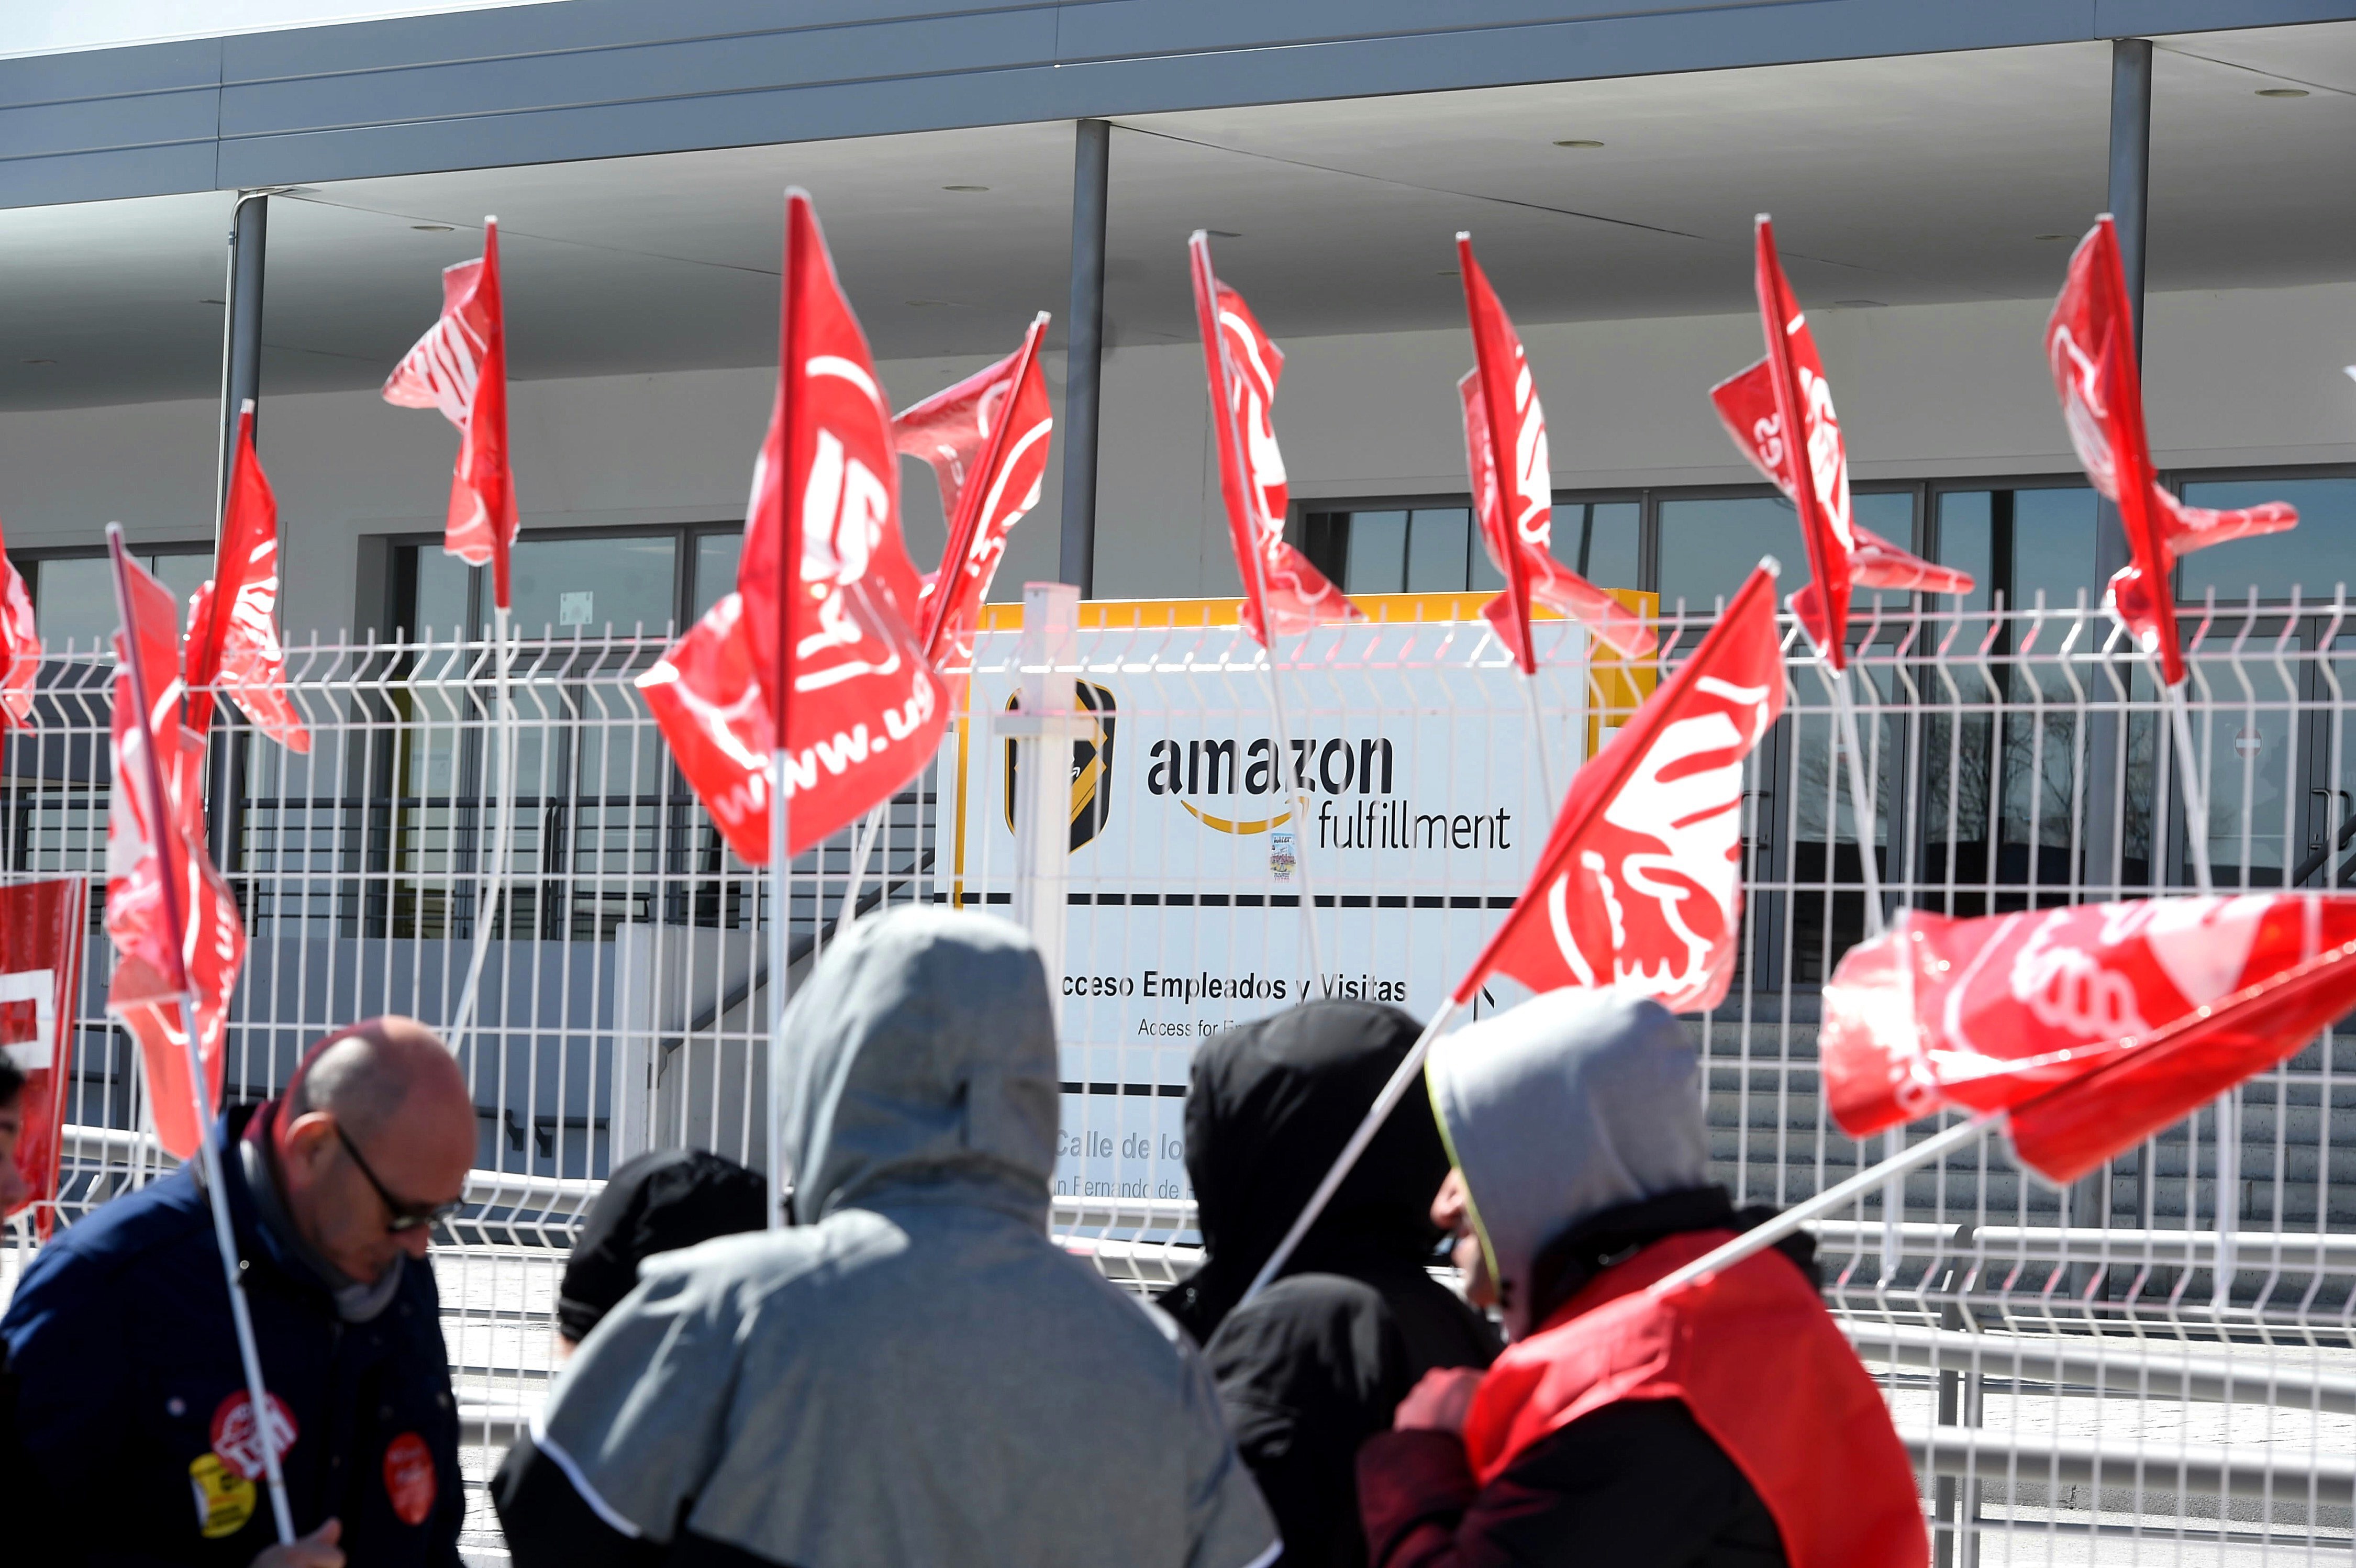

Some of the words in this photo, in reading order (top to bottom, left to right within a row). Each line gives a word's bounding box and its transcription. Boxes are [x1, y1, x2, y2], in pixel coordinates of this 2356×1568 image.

[1148, 737, 1393, 795] amazon
[1318, 799, 1511, 850] fulfillment
[1063, 974, 1134, 996] cceso
[1143, 970, 1287, 1005] Empleados
[1295, 980, 1311, 1006] y
[1320, 973, 1406, 1002] Visitas
[1138, 1018, 1192, 1037] Access
[1198, 1019, 1219, 1037] for
[1055, 1129, 1114, 1158] Calle
[1122, 1132, 1149, 1159] de
[1160, 1133, 1184, 1160] lo
[1074, 1175, 1151, 1198] Fernando
[1158, 1178, 1179, 1199] de
